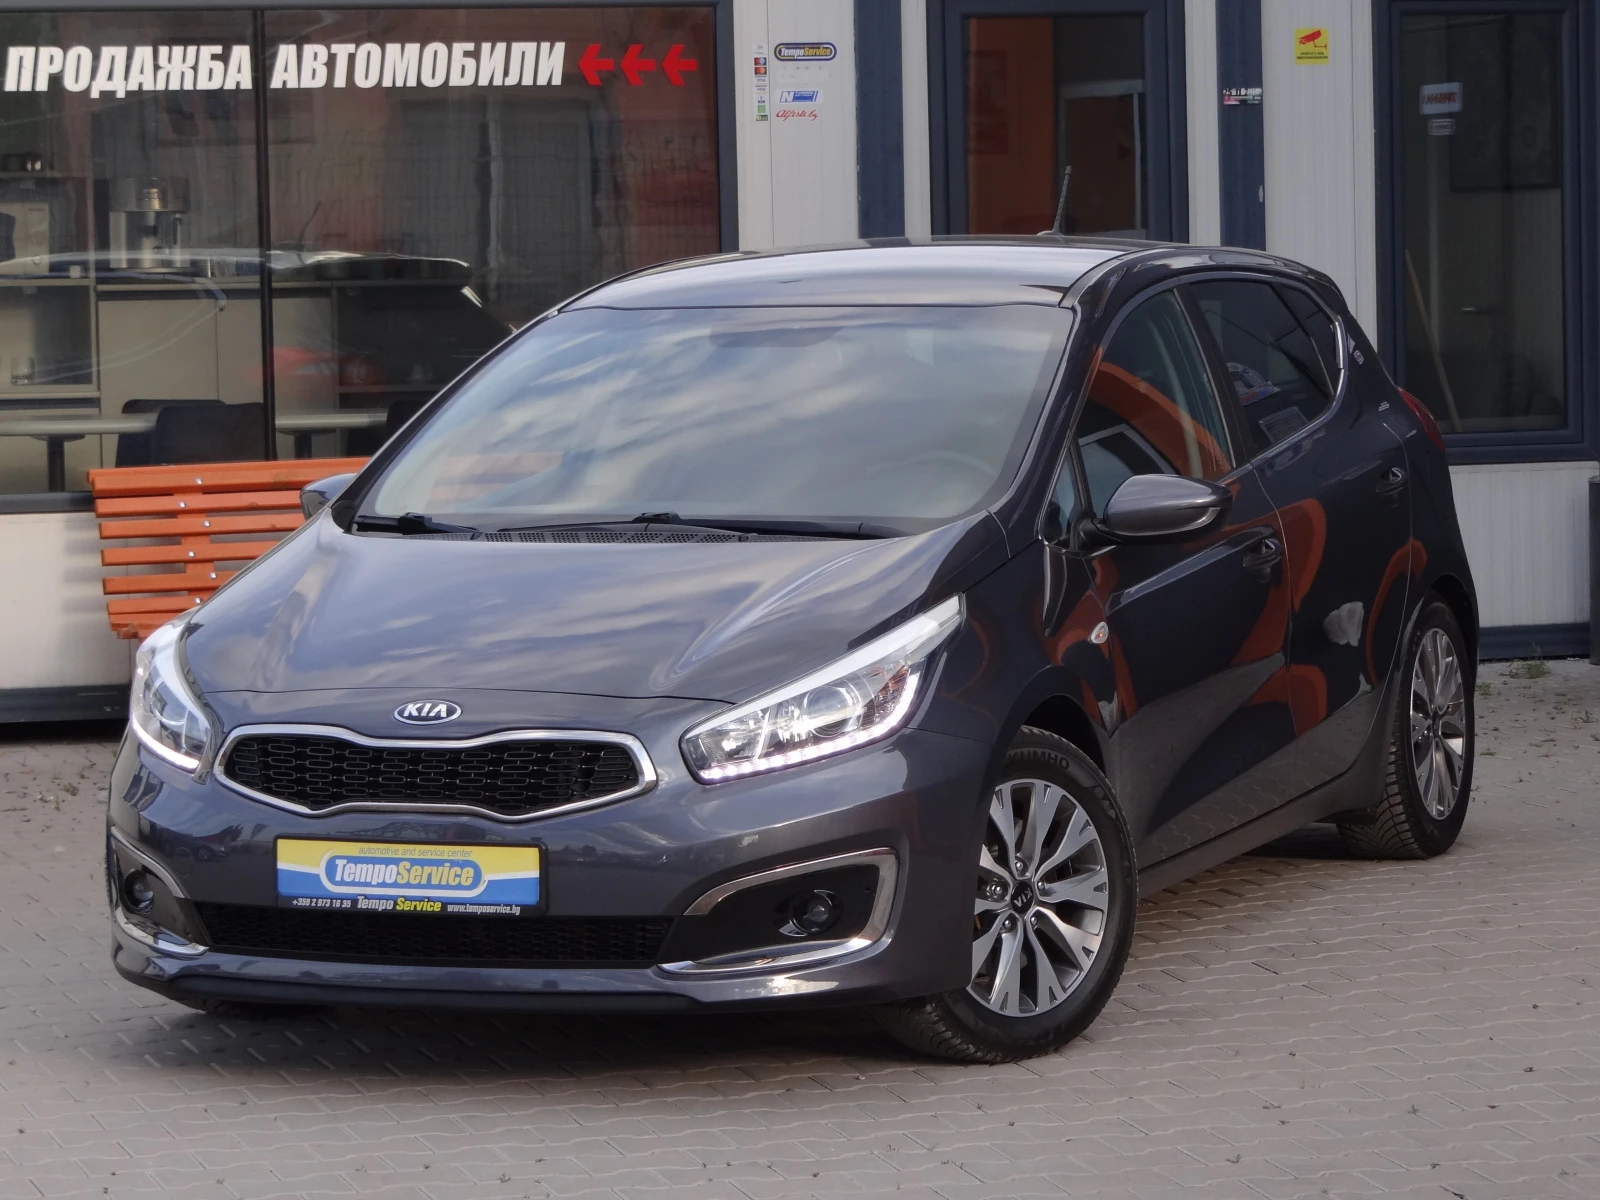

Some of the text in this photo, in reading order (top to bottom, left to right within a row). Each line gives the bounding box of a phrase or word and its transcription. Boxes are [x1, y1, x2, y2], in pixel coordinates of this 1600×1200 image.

[780, 47, 831, 59] TempoService
[4, 42, 566, 98] ПРОДАЖБА АВТОМОБИЛИ
[403, 703, 447, 718] KIA
[1007, 749, 1070, 770] KUMHO
[358, 846, 473, 858] automotive and service center
[335, 859, 475, 886] TempoService
[292, 897, 352, 908] +359 2 973 16 35
[357, 895, 442, 912] Tempo Service
[447, 903, 521, 915] www.temposervice.bg
